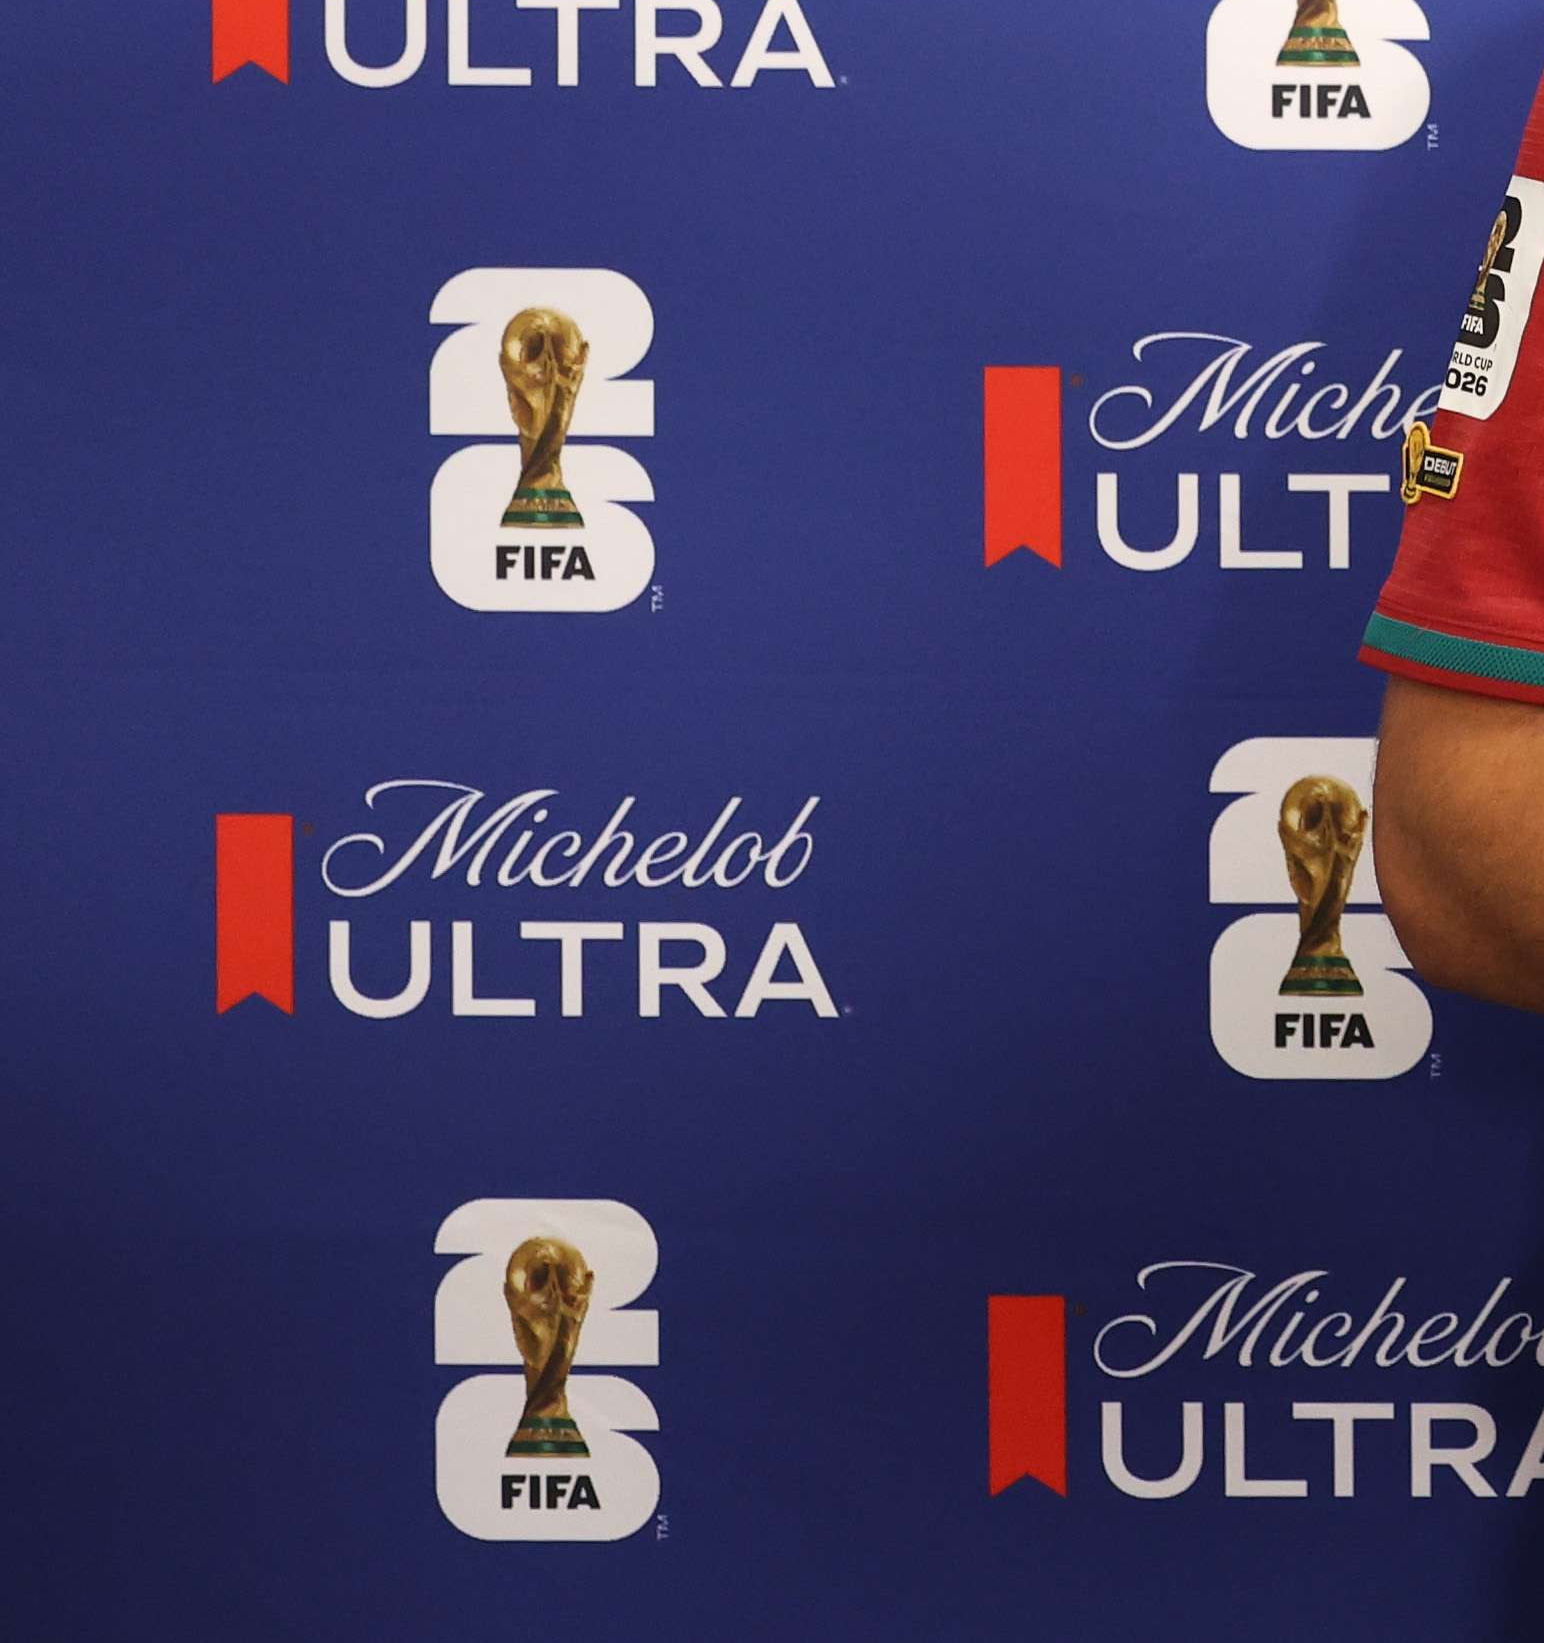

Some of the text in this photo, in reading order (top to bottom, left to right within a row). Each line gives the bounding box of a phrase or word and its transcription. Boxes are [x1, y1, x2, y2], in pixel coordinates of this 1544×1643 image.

[1270, 83, 1372, 120] FIFA
[1460, 313, 1485, 335] FIFA
[1474, 356, 1494, 372] CUP
[1095, 470, 1392, 573] ULT
[494, 544, 597, 581] FIFA
[320, 778, 822, 898] Michelob
[328, 919, 840, 1020] ULTRA
[1273, 1013, 1377, 1050] FIFA
[499, 1473, 602, 1511] FIFA
